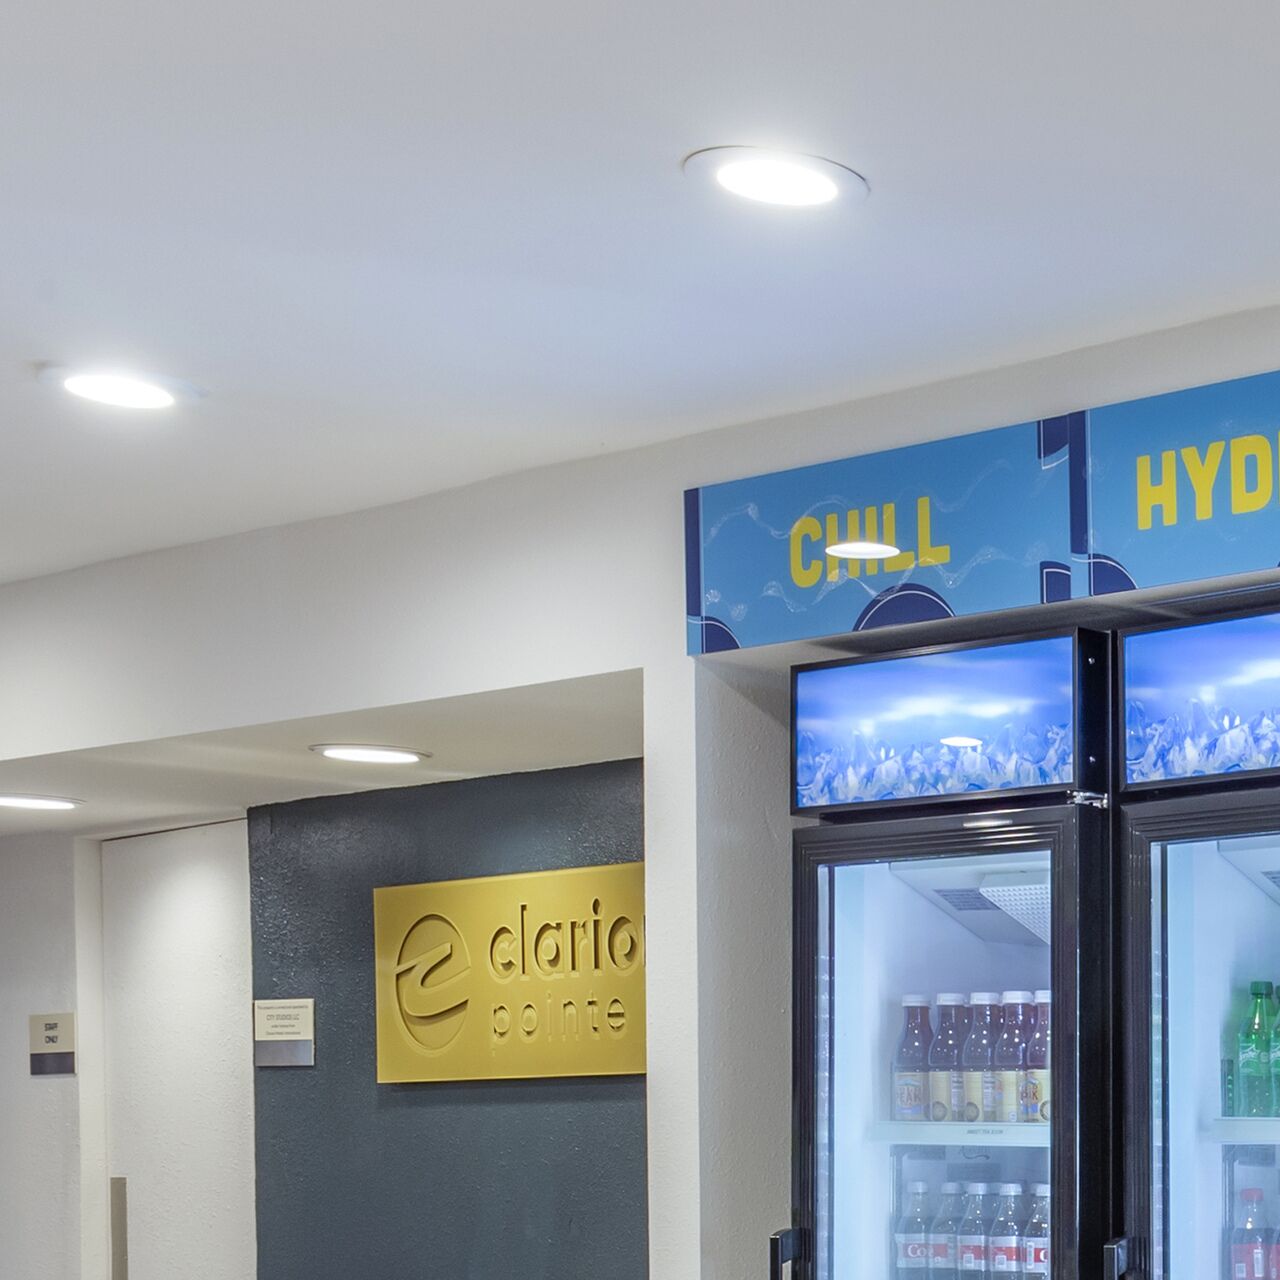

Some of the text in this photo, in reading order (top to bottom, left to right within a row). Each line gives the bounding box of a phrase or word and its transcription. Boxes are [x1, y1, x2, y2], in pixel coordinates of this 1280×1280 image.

[790, 497, 950, 588] CHILL
[489, 897, 646, 982] clario
[492, 991, 627, 1050] pointe
